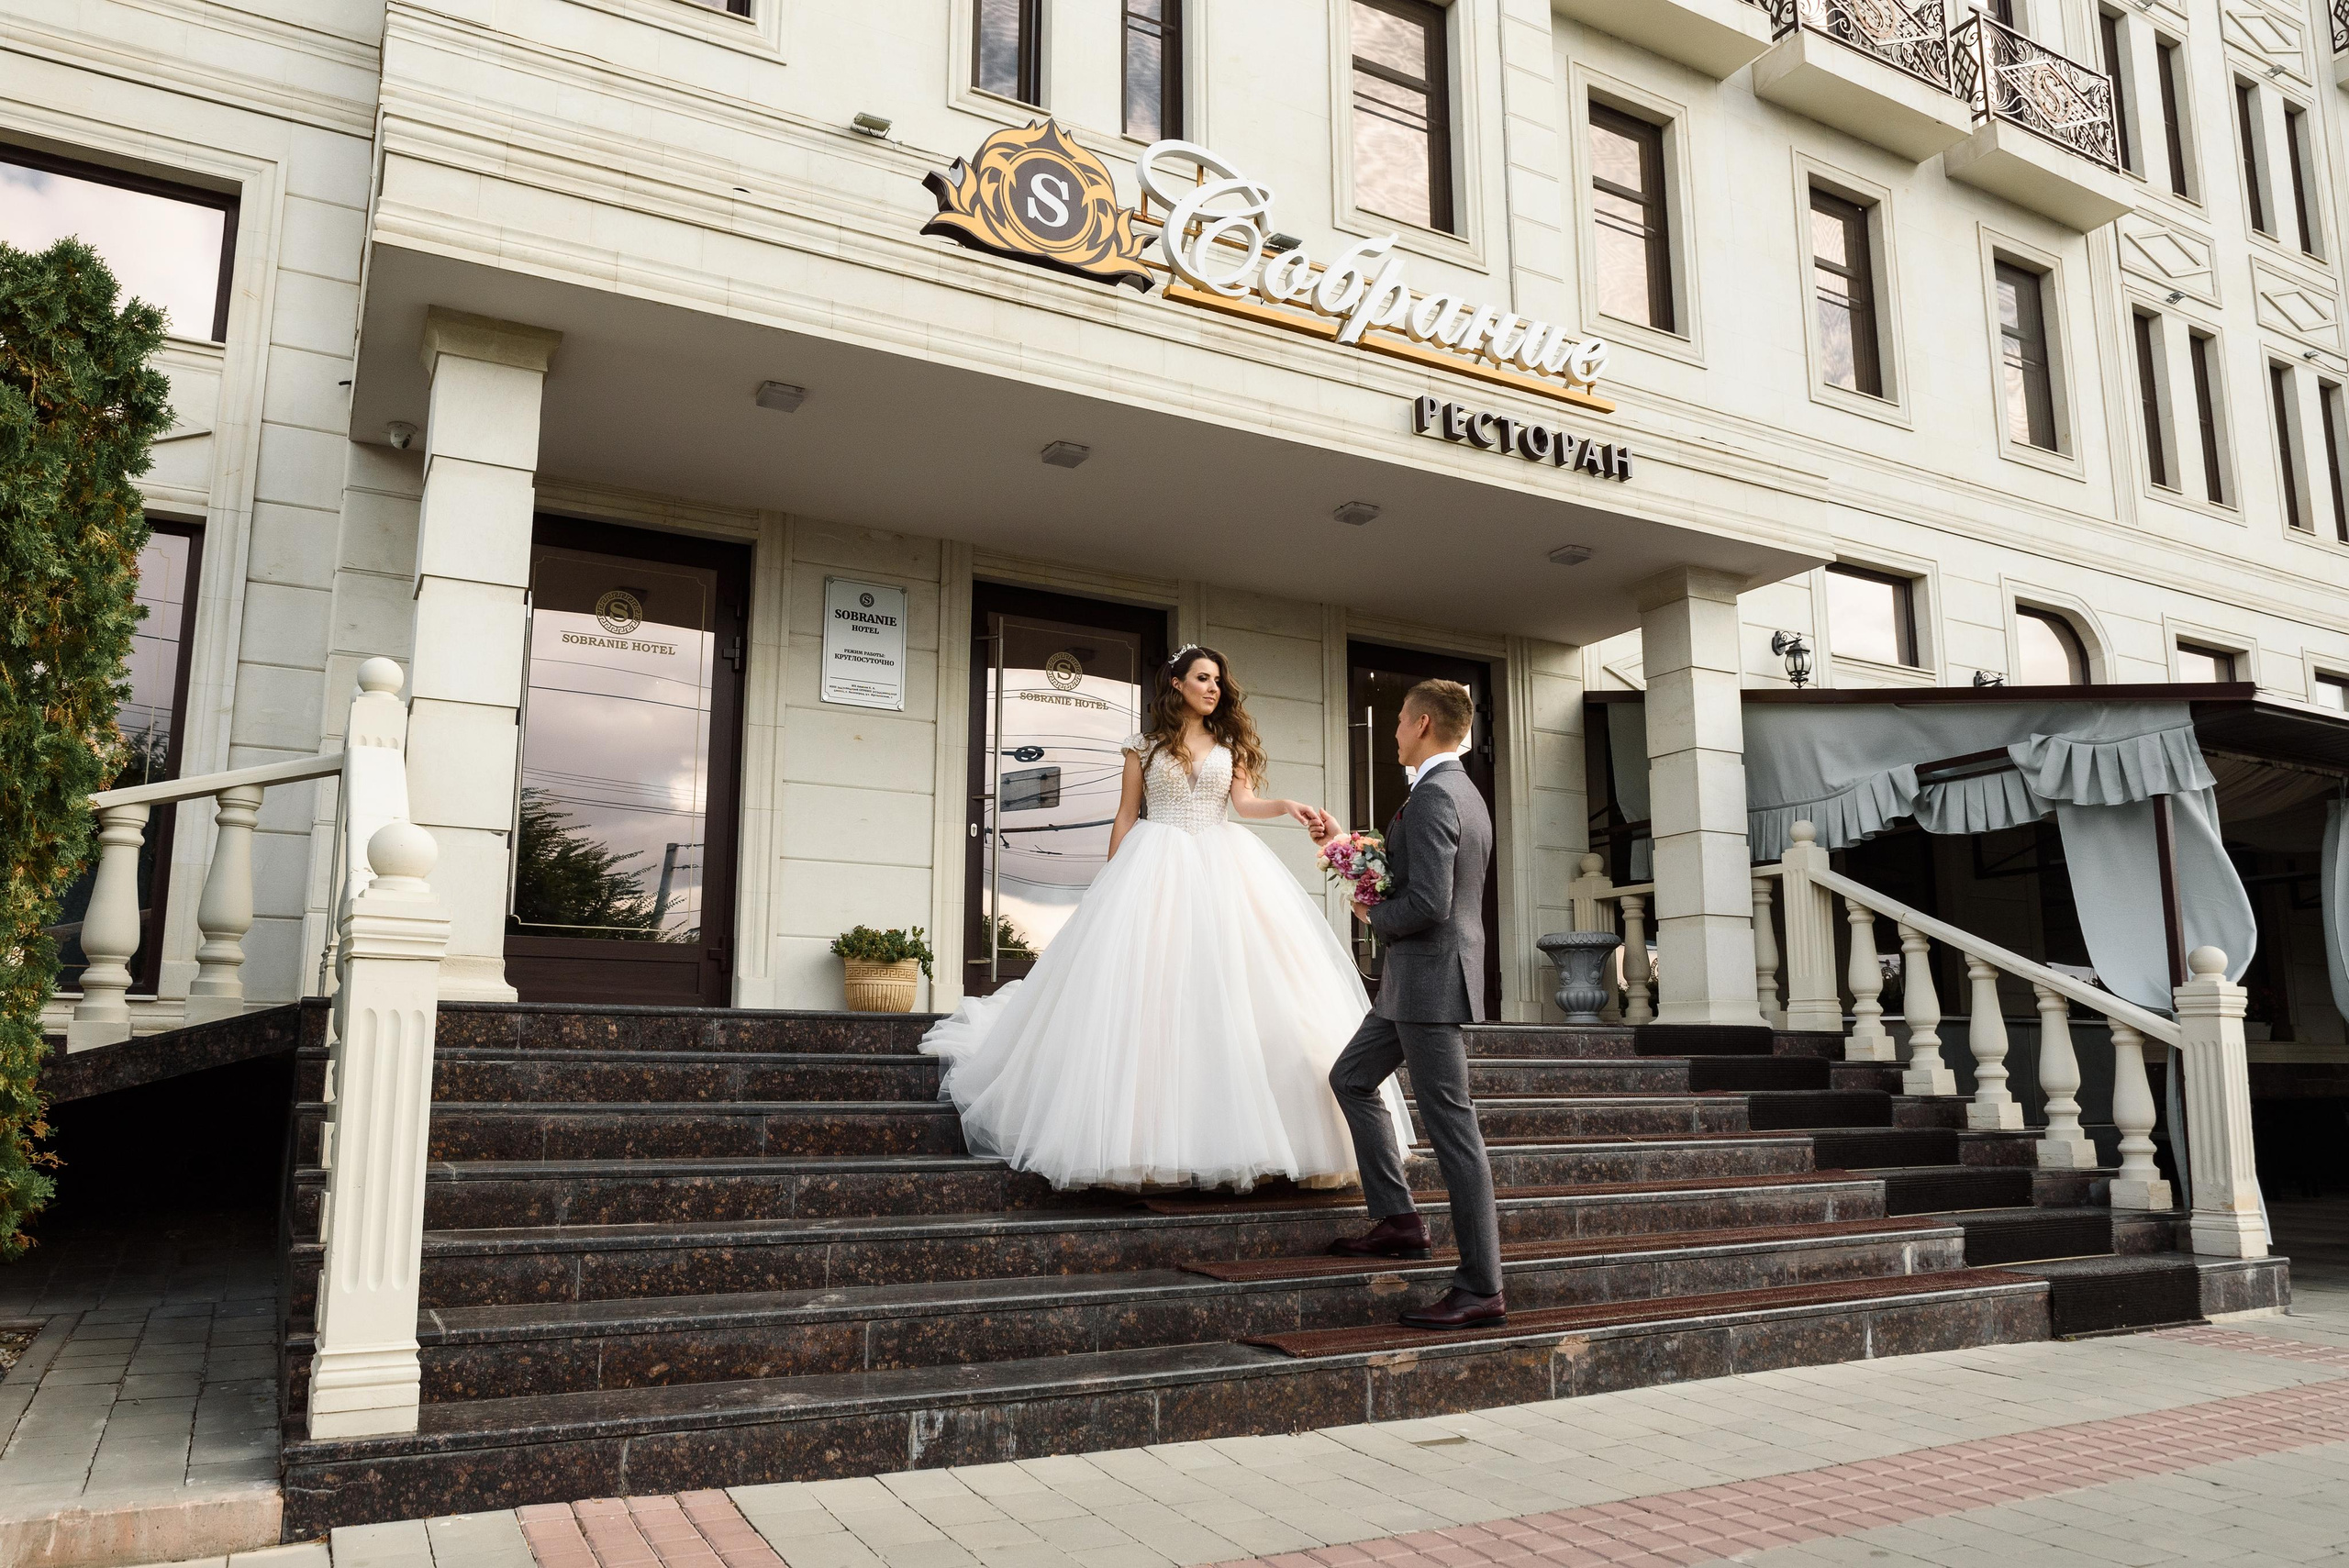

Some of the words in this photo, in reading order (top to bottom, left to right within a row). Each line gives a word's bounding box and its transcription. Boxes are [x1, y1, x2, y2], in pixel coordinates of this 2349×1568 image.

[1027, 172, 1070, 228] S
[1135, 138, 1611, 387] Собрание
[1415, 395, 1633, 482] РЕСТОРАН
[863, 595, 871, 605] S
[609, 602, 629, 622] S
[834, 608, 897, 627] SOBRANIE
[852, 624, 880, 635] HOTEL
[562, 633, 629, 650] SOBRANIE
[631, 641, 676, 655] HOTEL
[834, 652, 895, 667] КРУГЛОСУТОЧНО
[1057, 662, 1073, 680] S
[1019, 692, 1072, 706] SOBRANIE
[1074, 698, 1109, 711] HOTEL
